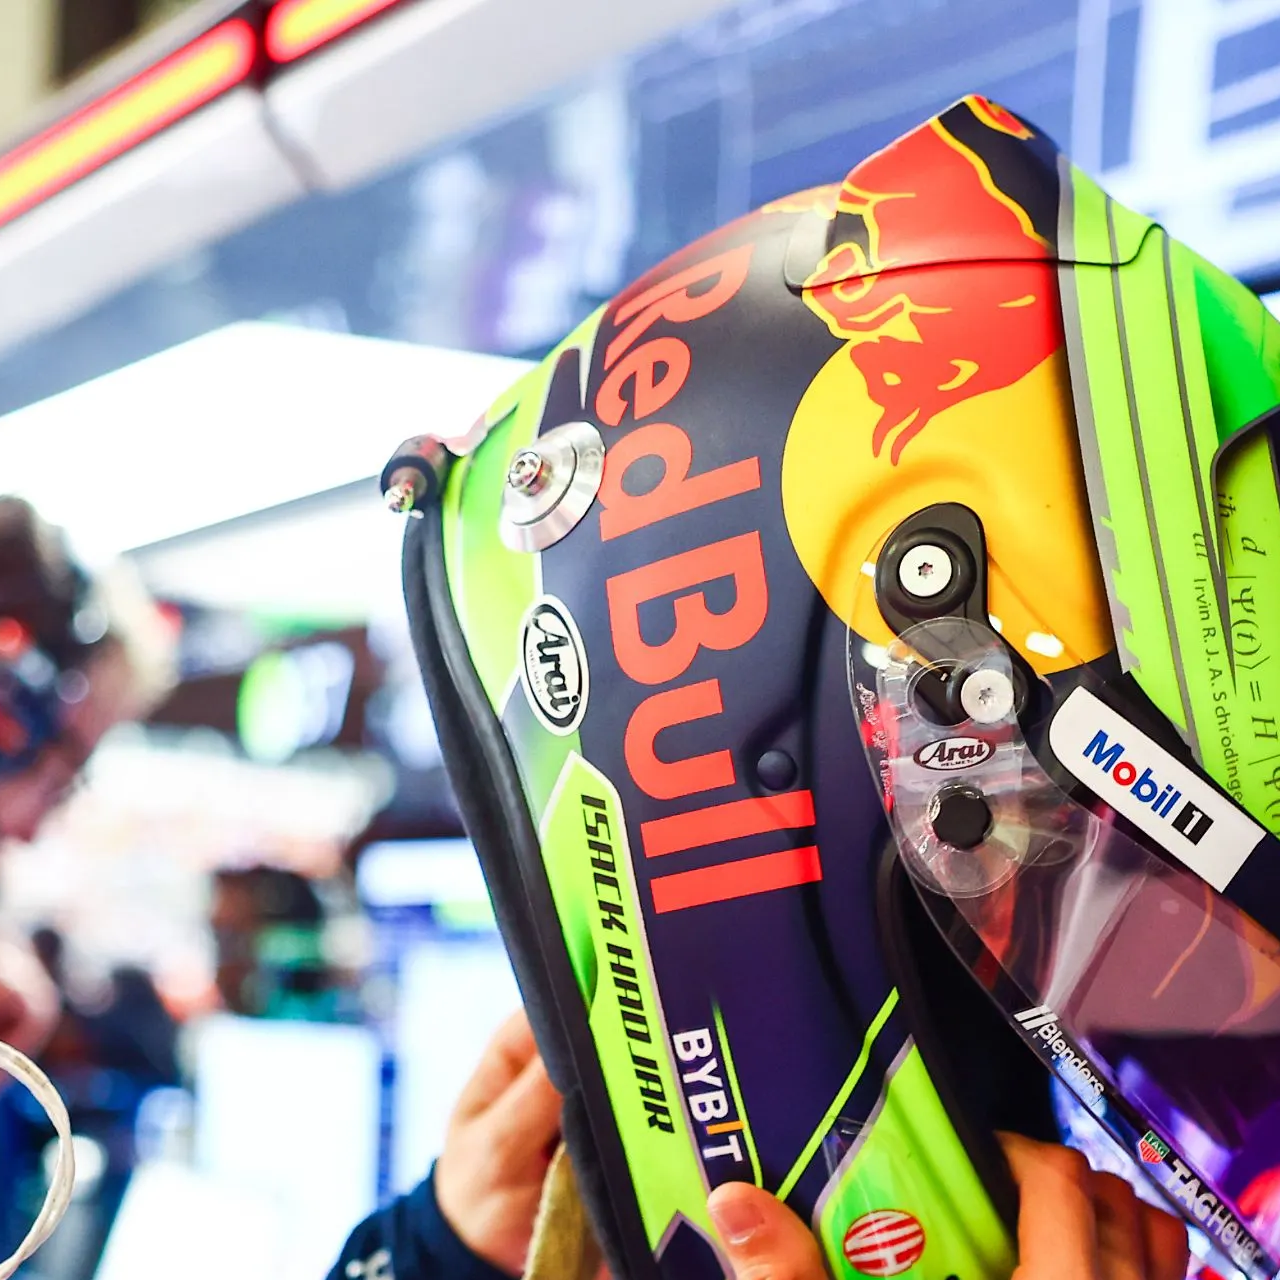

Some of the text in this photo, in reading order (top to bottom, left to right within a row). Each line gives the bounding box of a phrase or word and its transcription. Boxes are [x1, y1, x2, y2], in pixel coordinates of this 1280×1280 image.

[594, 243, 823, 915] Red Bull
[532, 617, 581, 713] Arai
[921, 738, 987, 766] Arai
[1082, 729, 1182, 819] Mobil
[581, 793, 676, 1135] ISACK HADJAR
[673, 1028, 746, 1162] BYBIT
[1037, 1022, 1105, 1096] Blenders
